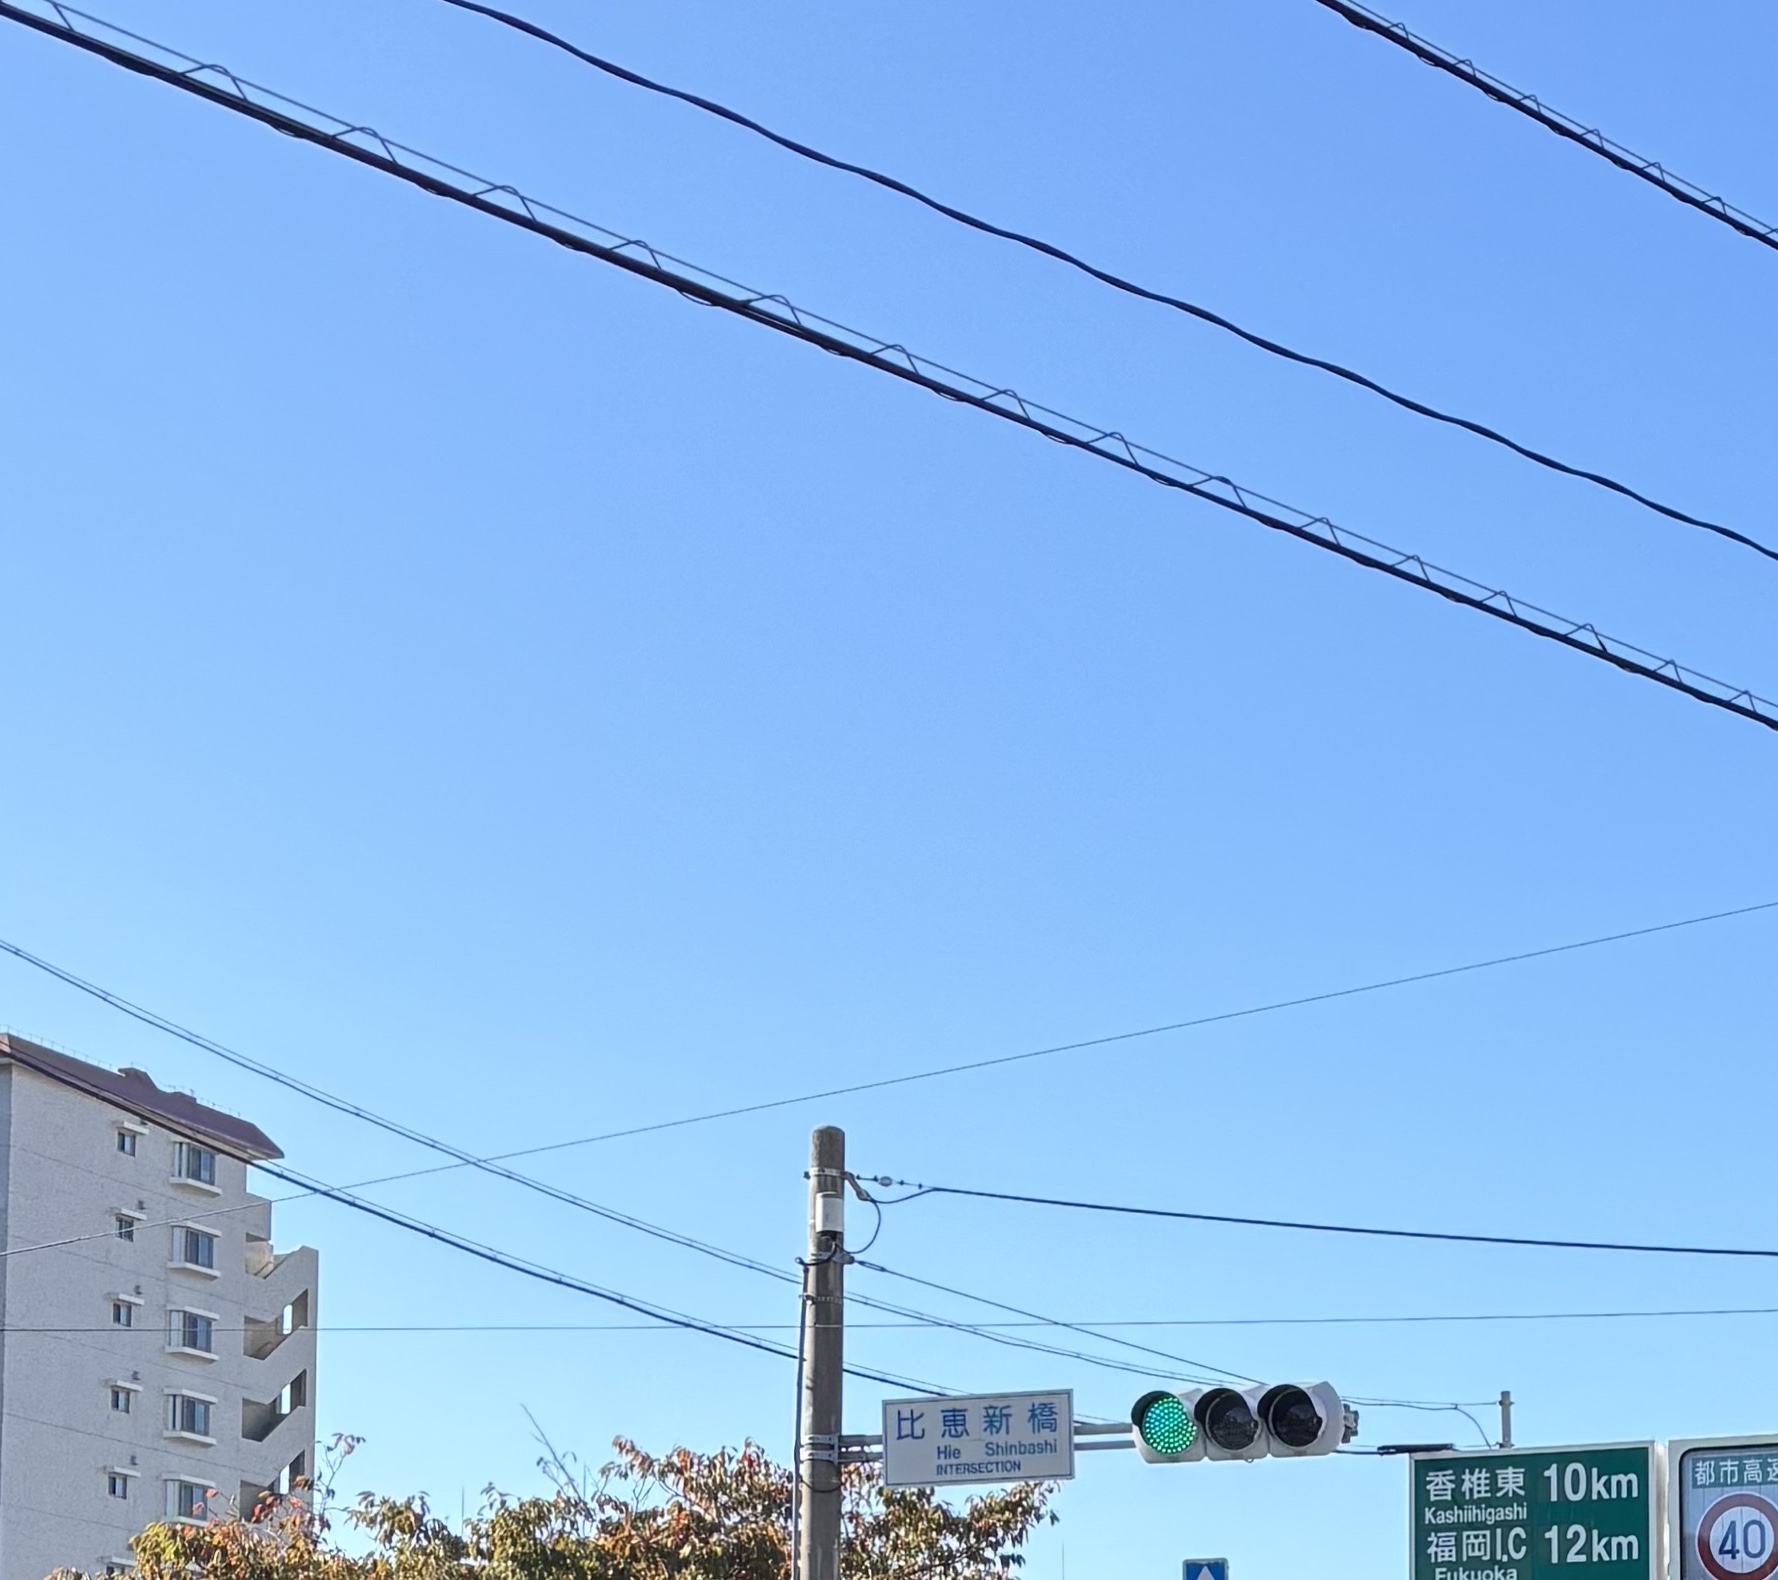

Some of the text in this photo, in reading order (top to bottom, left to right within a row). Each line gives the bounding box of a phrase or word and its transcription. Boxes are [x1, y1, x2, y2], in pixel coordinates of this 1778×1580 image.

[896, 1402, 1059, 1441] 比恵新橋
[936, 1460, 1021, 1476] INTERSECTION
[937, 1438, 1058, 1460] Hie Shinbashi
[1425, 1462, 1639, 1502] 香椎東 10km
[1424, 1502, 1528, 1525] Kashiihigashi
[1543, 1523, 1639, 1564] 12km
[1718, 1518, 1767, 1560] 40
